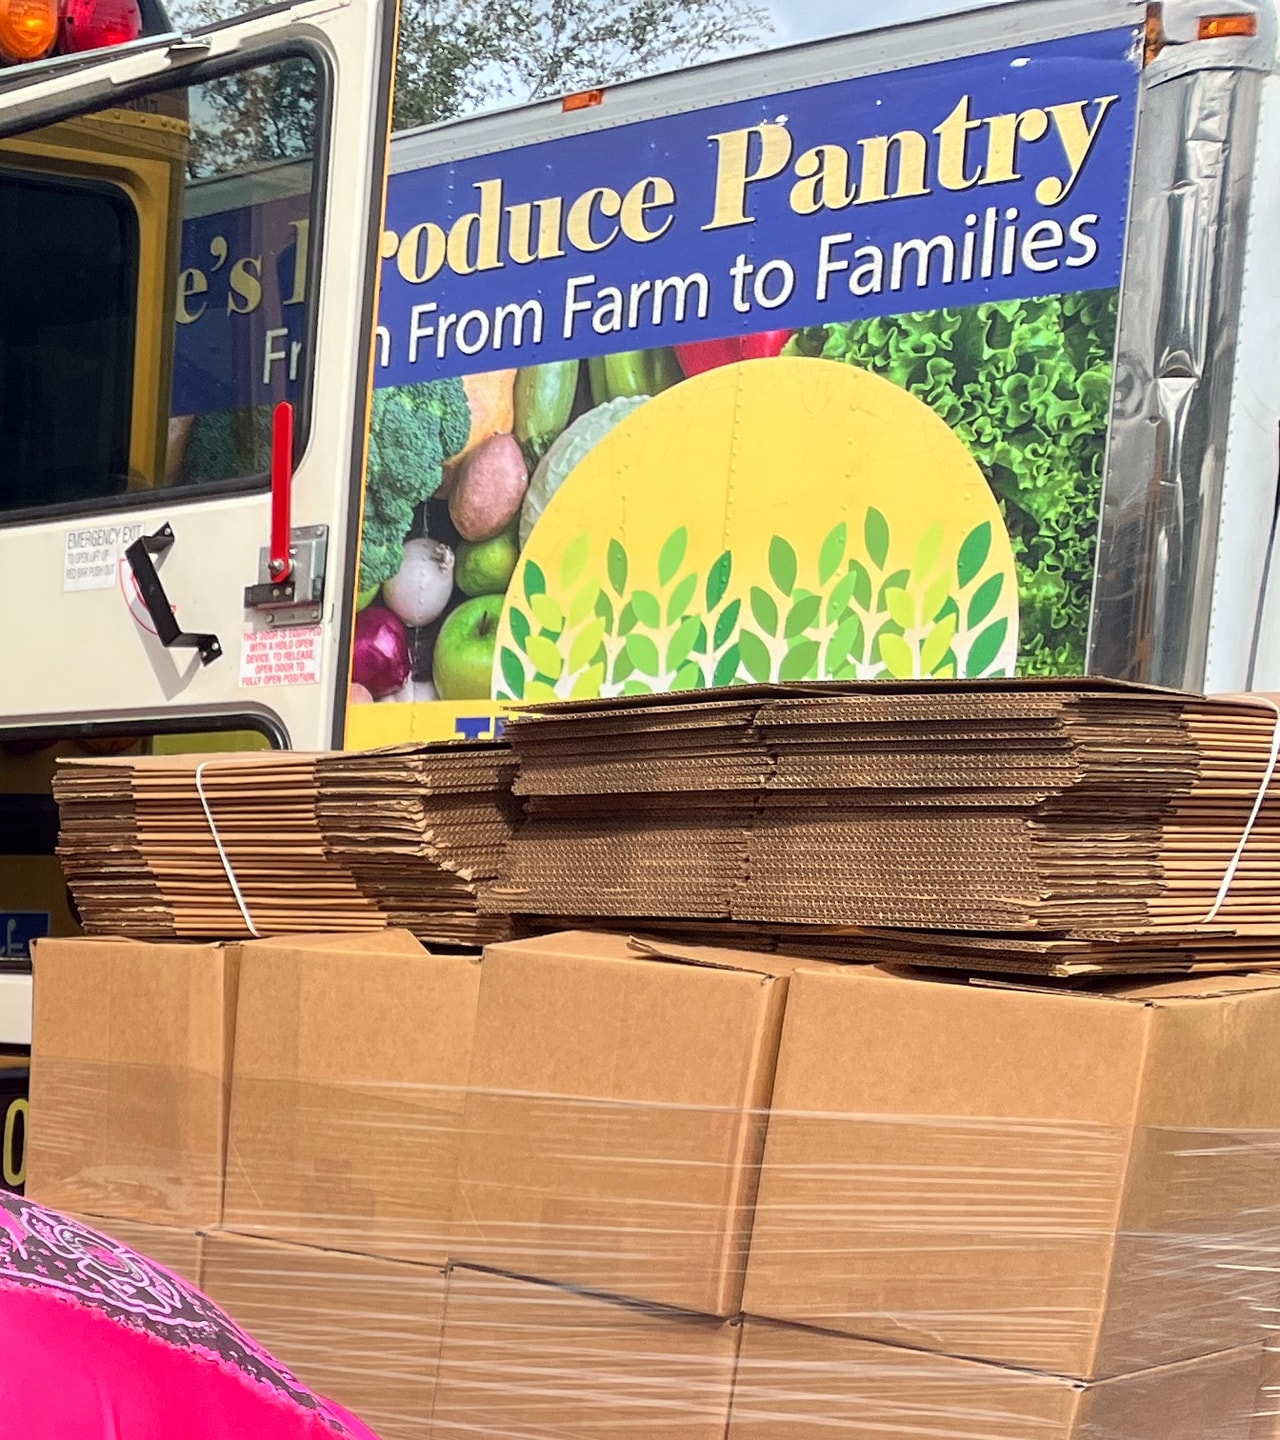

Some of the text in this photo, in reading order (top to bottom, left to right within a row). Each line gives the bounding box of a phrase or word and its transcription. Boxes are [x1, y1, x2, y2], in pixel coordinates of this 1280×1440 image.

[700, 94, 1119, 230] Pantry
[407, 301, 545, 363] From
[562, 274, 711, 340] Farm
[730, 253, 796, 313] to
[816, 206, 1099, 302] Families
[67, 525, 142, 550] EMERGENCY EXIT
[249, 639, 314, 652] WITH A HOLD OPEN
[273, 652, 282, 661] TO
[255, 662, 305, 675] OPEN DOOR TO
[242, 676, 261, 686] FULLY
[263, 674, 282, 685] OPEN
